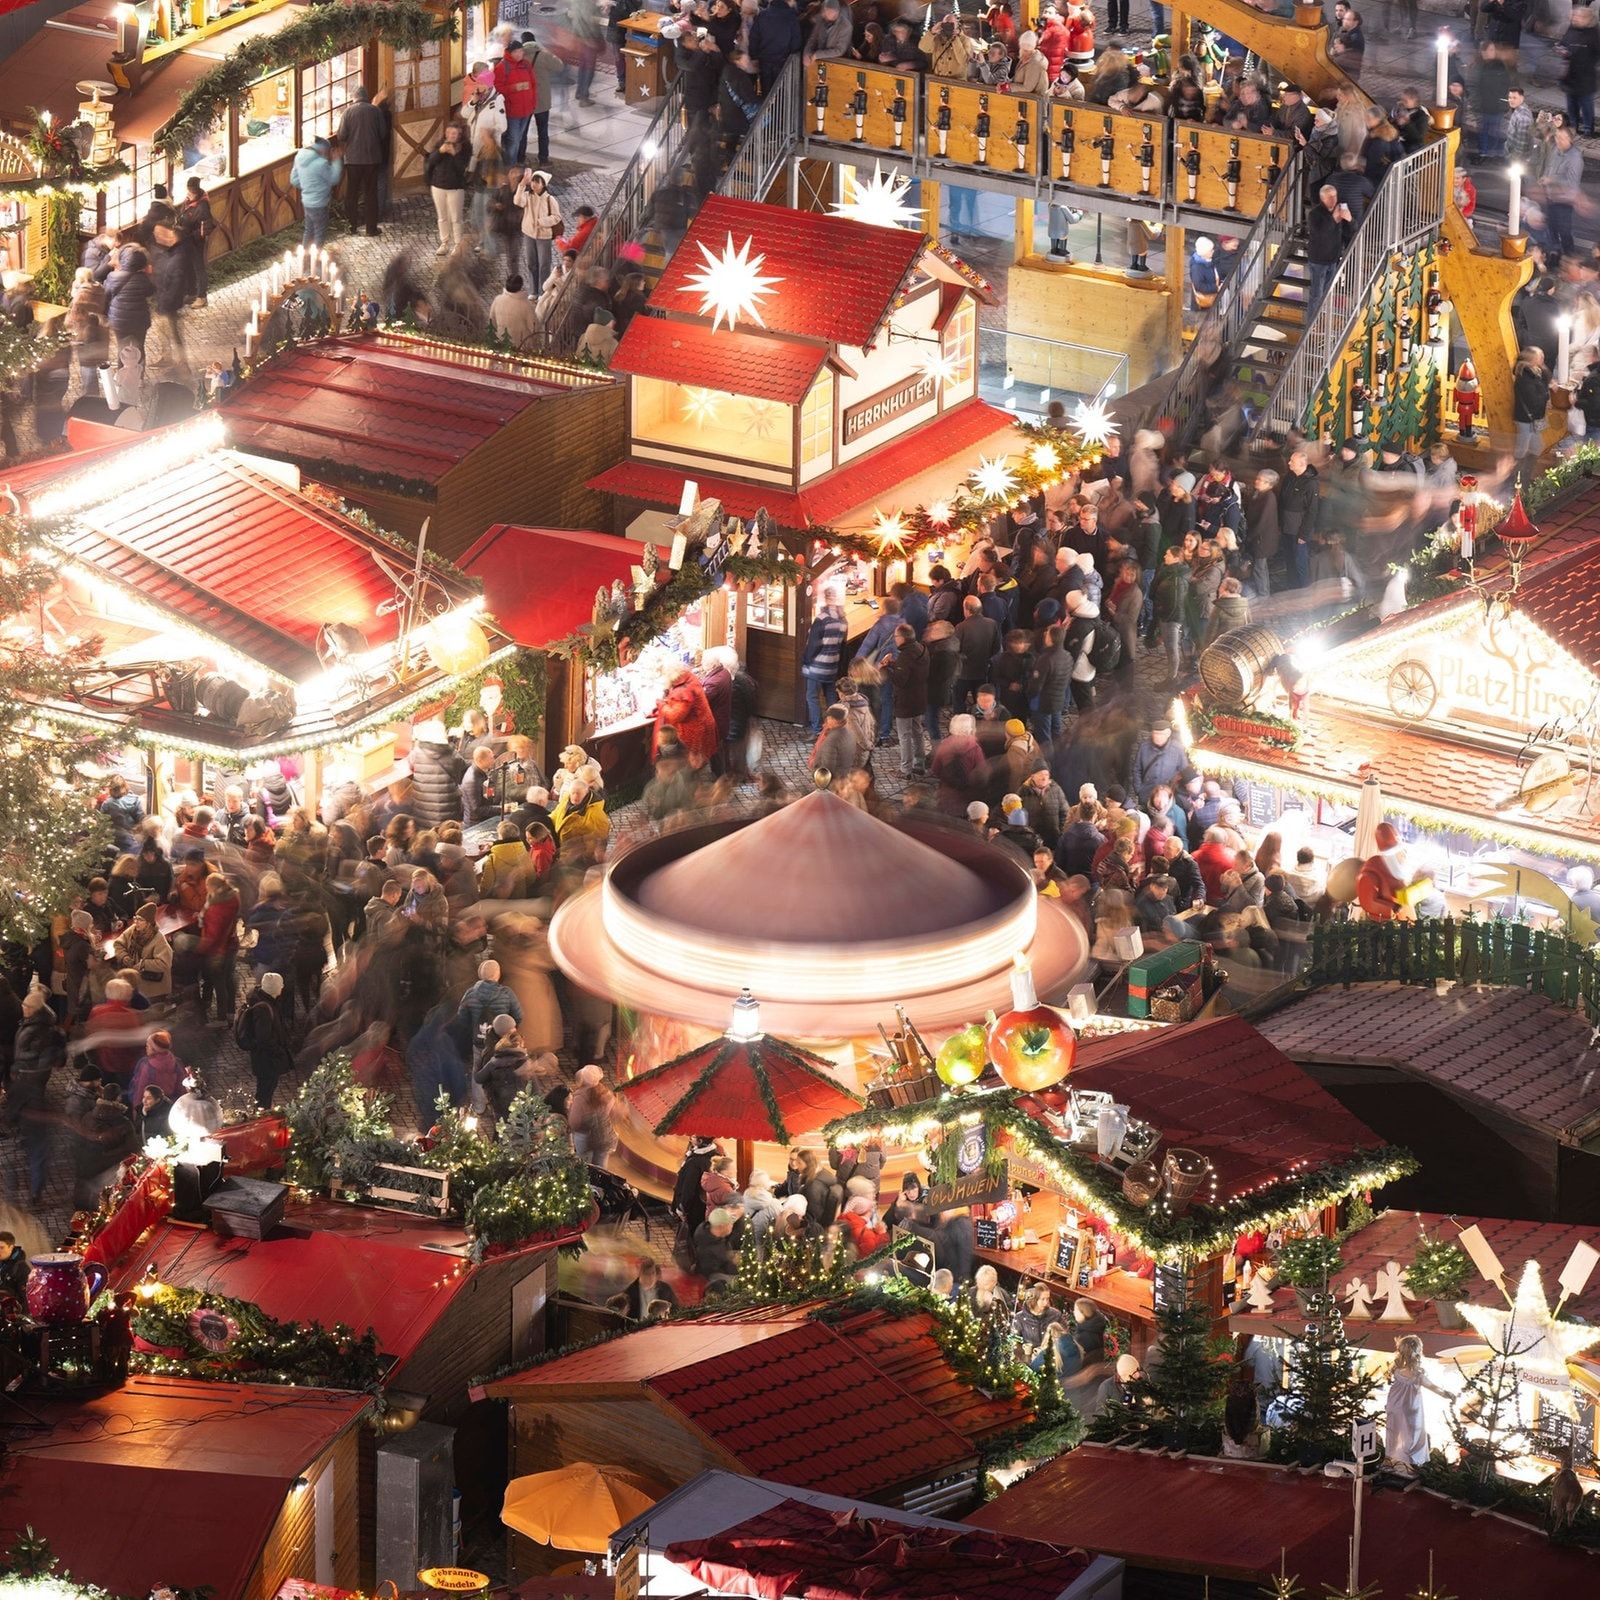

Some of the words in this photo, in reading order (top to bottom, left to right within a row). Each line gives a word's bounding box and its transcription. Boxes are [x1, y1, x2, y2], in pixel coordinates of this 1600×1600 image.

[847, 379, 932, 436] HERRNHUTER
[1439, 654, 1598, 719] PlatzHirsc
[1522, 1371, 1559, 1386] Raddatz
[1360, 1432, 1373, 1452] H
[431, 1569, 479, 1579] Gebrannte
[436, 1579, 477, 1588] Mandeln
